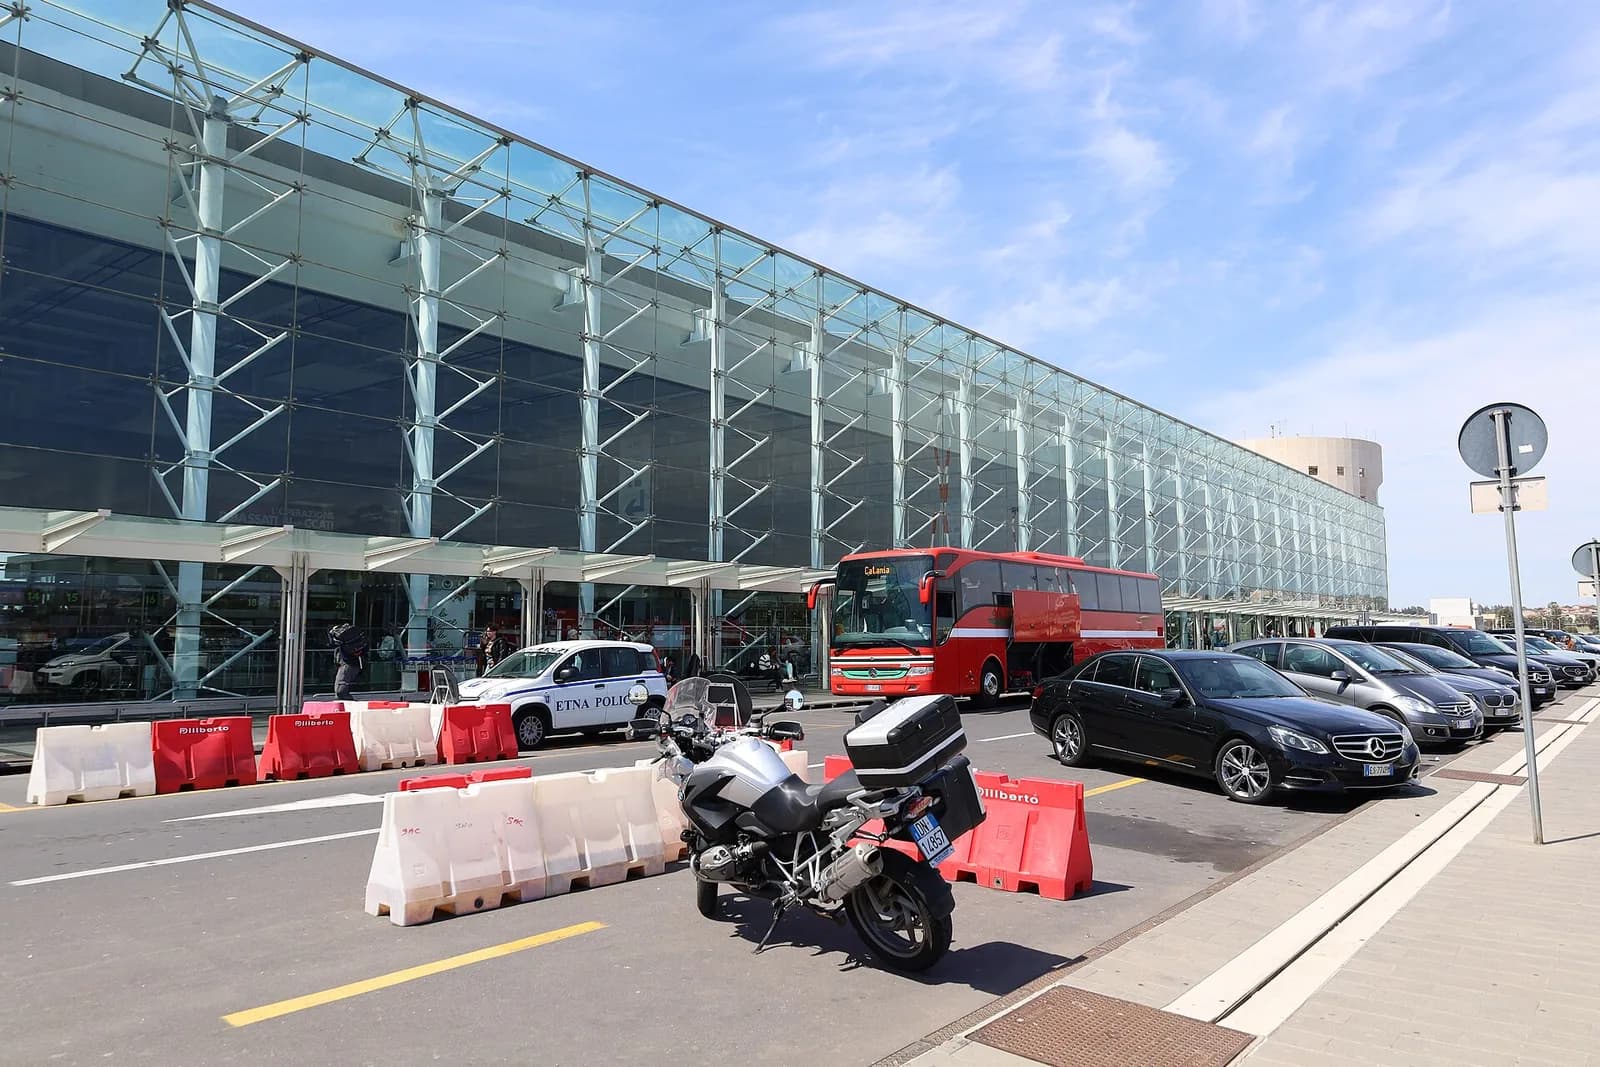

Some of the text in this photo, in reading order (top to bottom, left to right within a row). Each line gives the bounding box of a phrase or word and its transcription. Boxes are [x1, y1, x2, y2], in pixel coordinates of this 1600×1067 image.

[864, 565, 890, 575] Catania
[335, 600, 346, 609] 20
[556, 695, 631, 712] ETNA POLIC
[179, 725, 229, 735] Diliberto
[915, 819, 930, 836] DN
[921, 829, 946, 856] 14857
